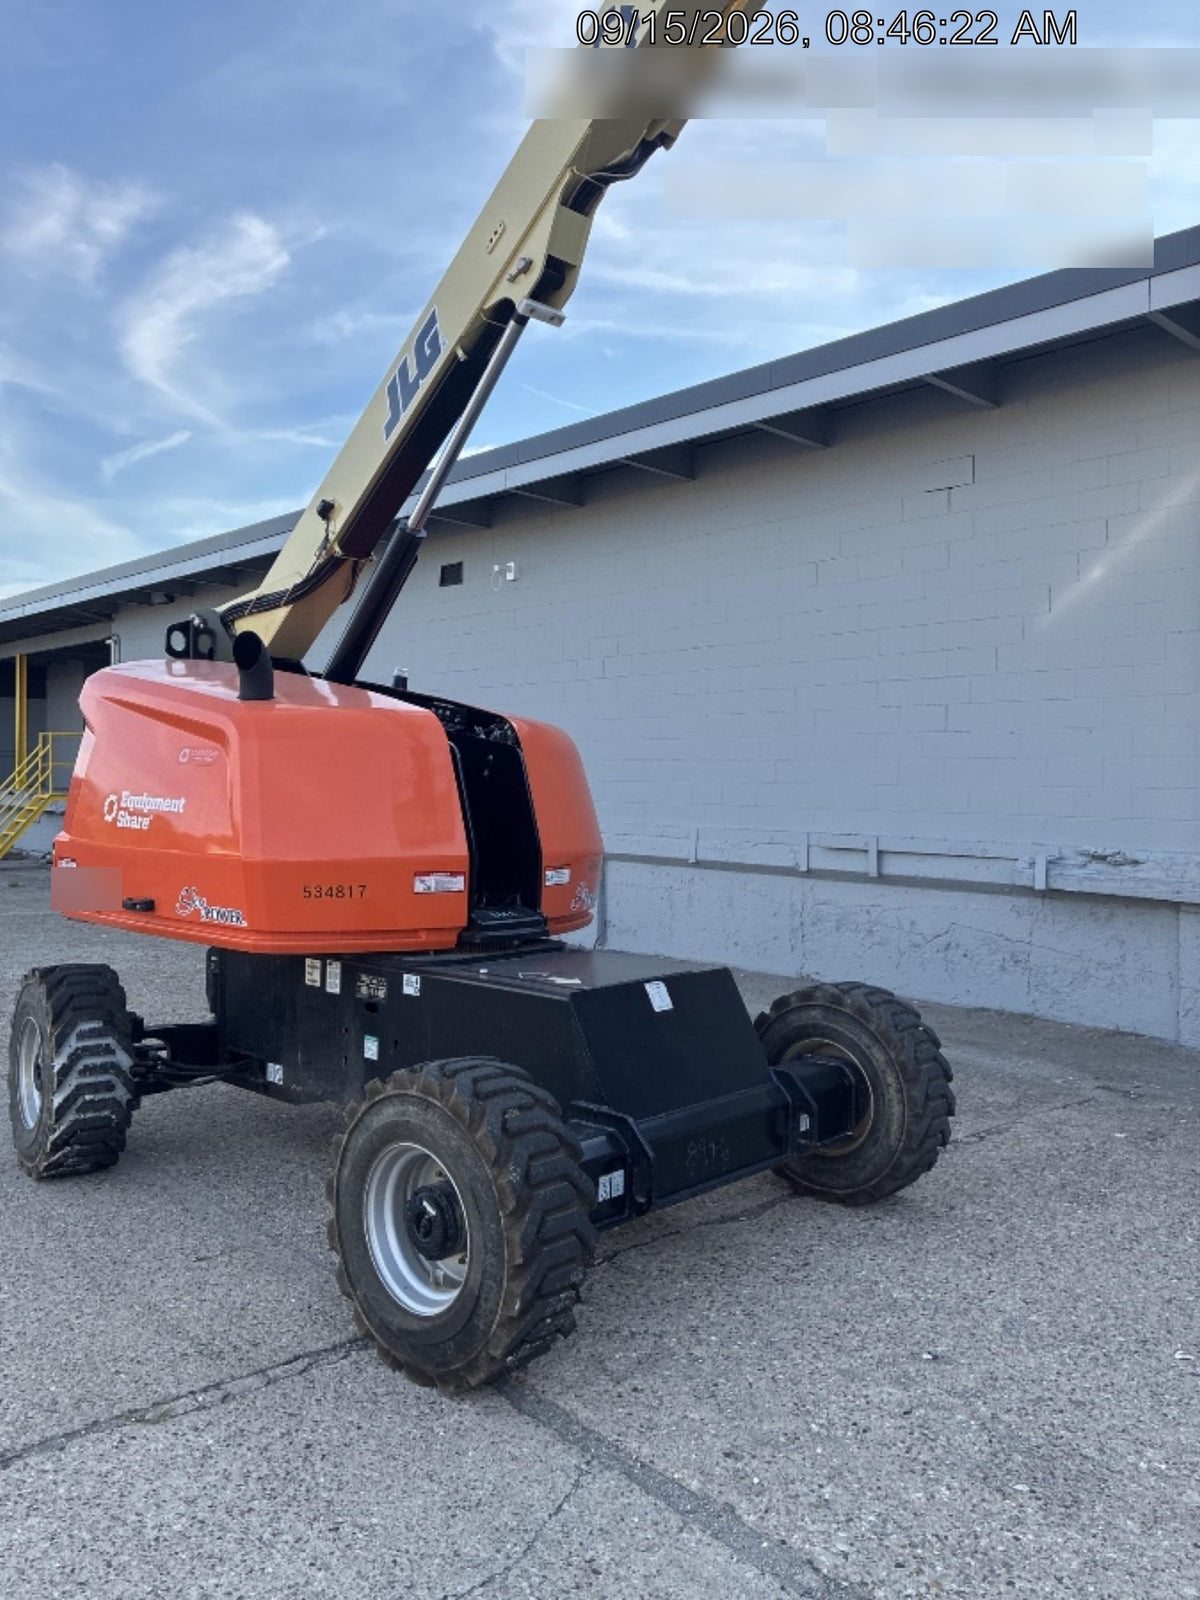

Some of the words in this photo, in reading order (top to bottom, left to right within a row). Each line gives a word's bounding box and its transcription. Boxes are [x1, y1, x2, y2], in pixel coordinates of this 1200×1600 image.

[382, 303, 443, 442] JLG
[120, 790, 186, 814] Equipment
[116, 810, 151, 830] Share
[302, 884, 367, 899] 534817
